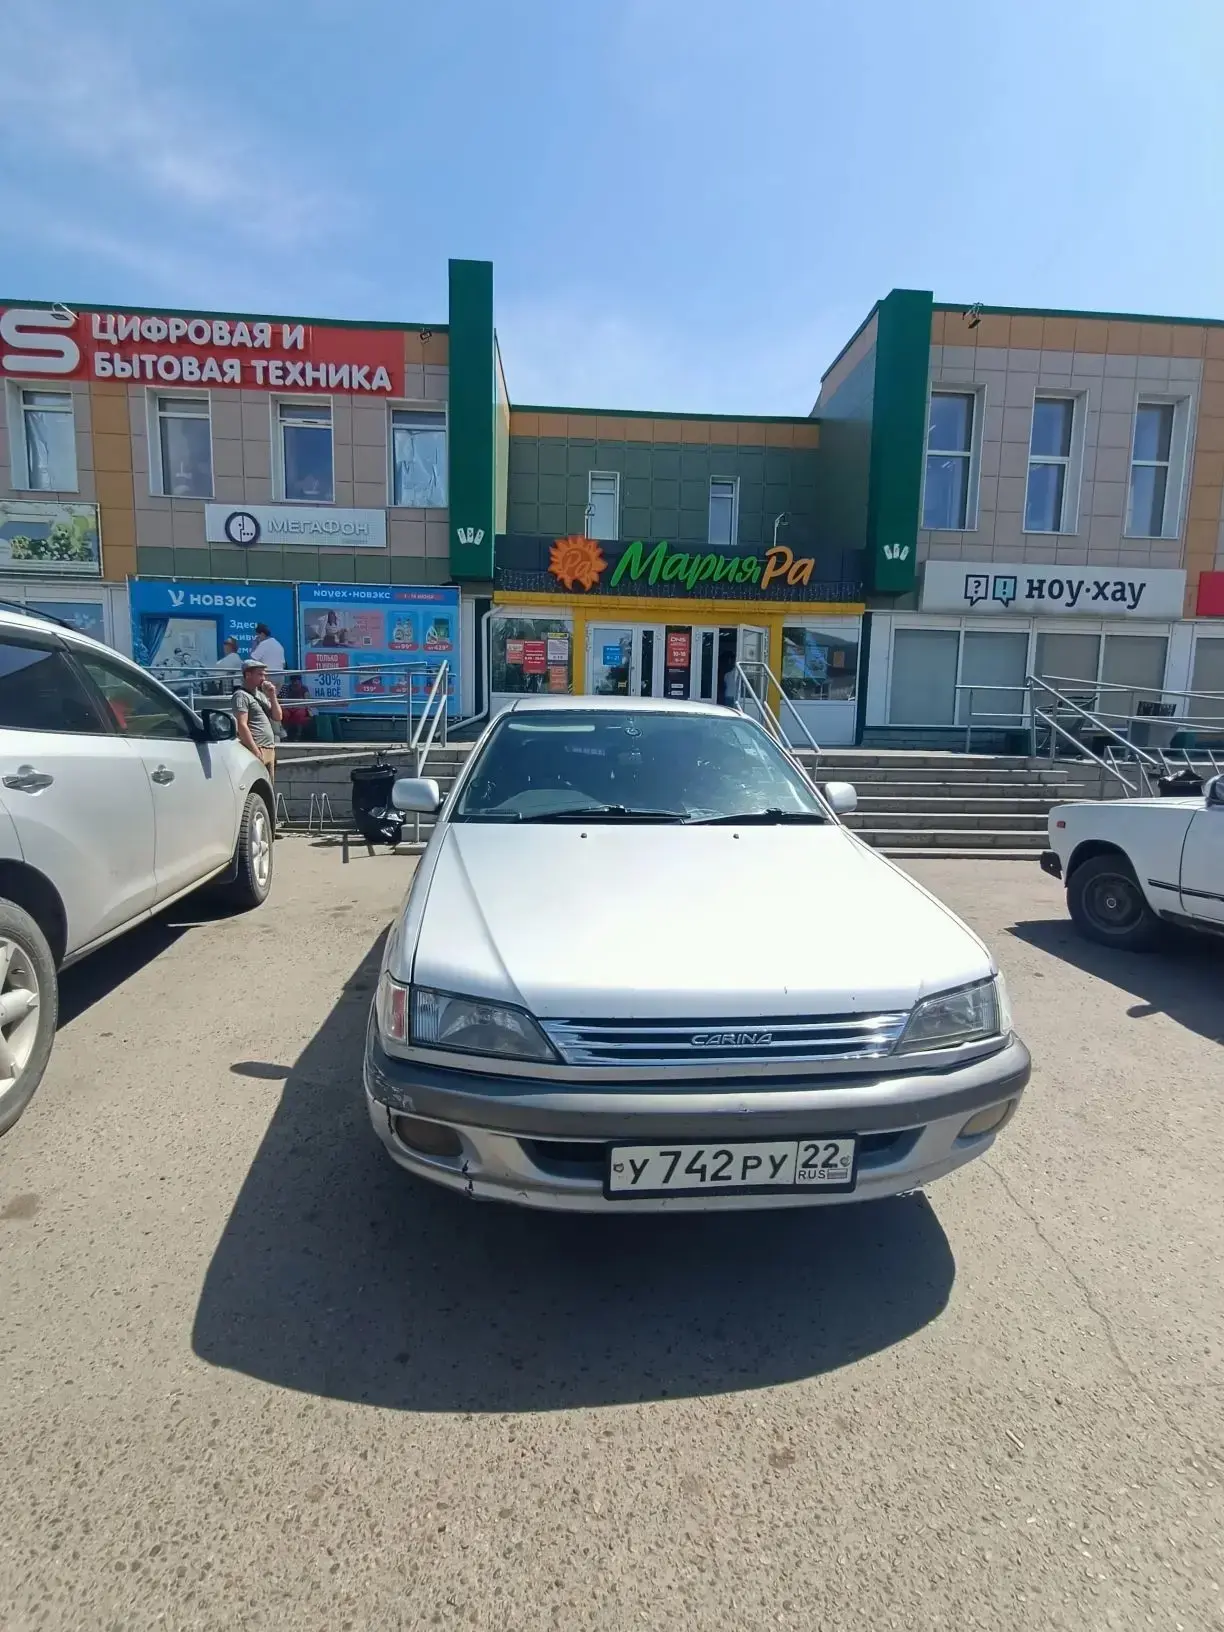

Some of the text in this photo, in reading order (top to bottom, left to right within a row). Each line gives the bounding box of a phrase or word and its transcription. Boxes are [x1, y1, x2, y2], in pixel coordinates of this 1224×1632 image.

[92, 313, 305, 350] ЦИФРОВАЯ И
[94, 352, 393, 392] БЫТОВАЯ ТЕХНИКА
[268, 518, 369, 536] МЕГАФОН
[189, 593, 257, 608] НОВЭКС
[315, 654, 338, 662] ТОЛЬКО
[314, 673, 341, 686] -30%
[315, 687, 325, 697] НА
[691, 1033, 773, 1045] CARINA
[801, 1143, 840, 1169] 22
[798, 1169, 826, 1180] RUS
